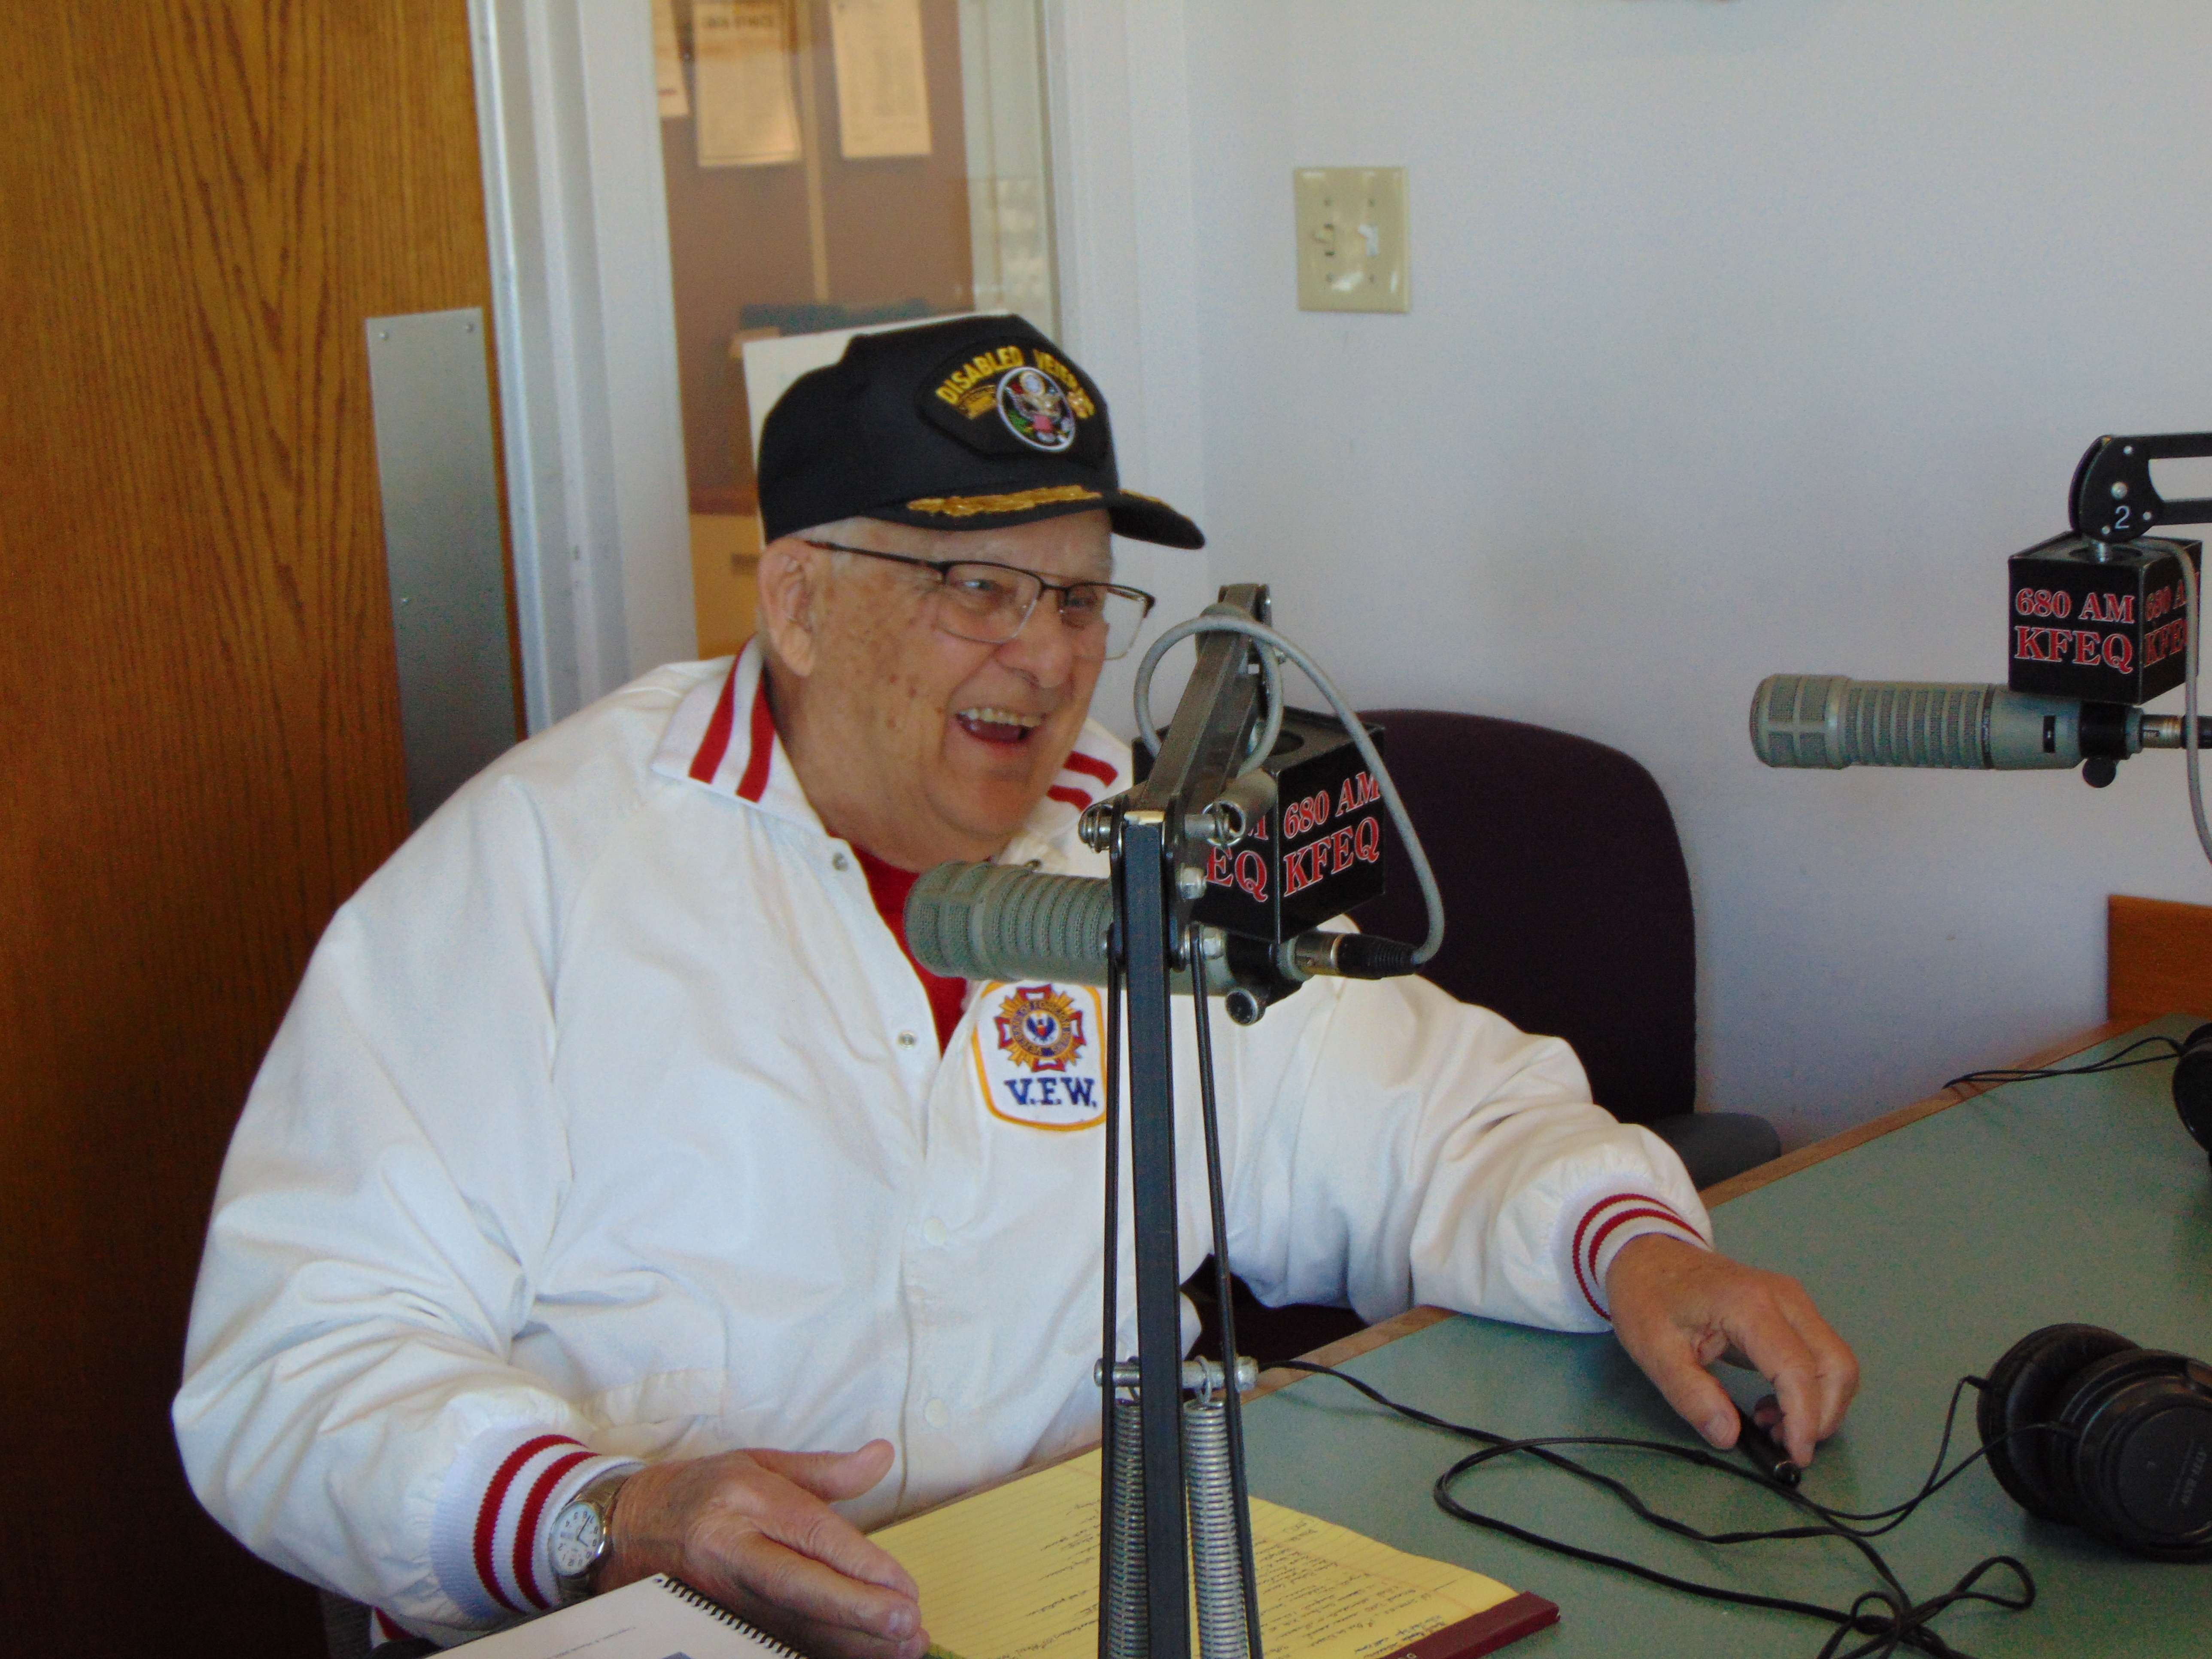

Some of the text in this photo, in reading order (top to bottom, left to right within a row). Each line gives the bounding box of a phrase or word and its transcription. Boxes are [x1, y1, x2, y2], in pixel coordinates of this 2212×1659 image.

[936, 345, 1025, 404] DISABLED
[2115, 505, 2130, 529] 2
[2015, 588, 2135, 624] 680 AM
[2014, 625, 2133, 674] KFEQ
[2144, 618, 2191, 668] KFE
[1284, 790, 1329, 839] 680
[1335, 772, 1380, 817] AM
[1205, 846, 1268, 902] EQ
[1283, 817, 1379, 897] KFEQ
[1004, 1076, 1097, 1108] V.F.W.
